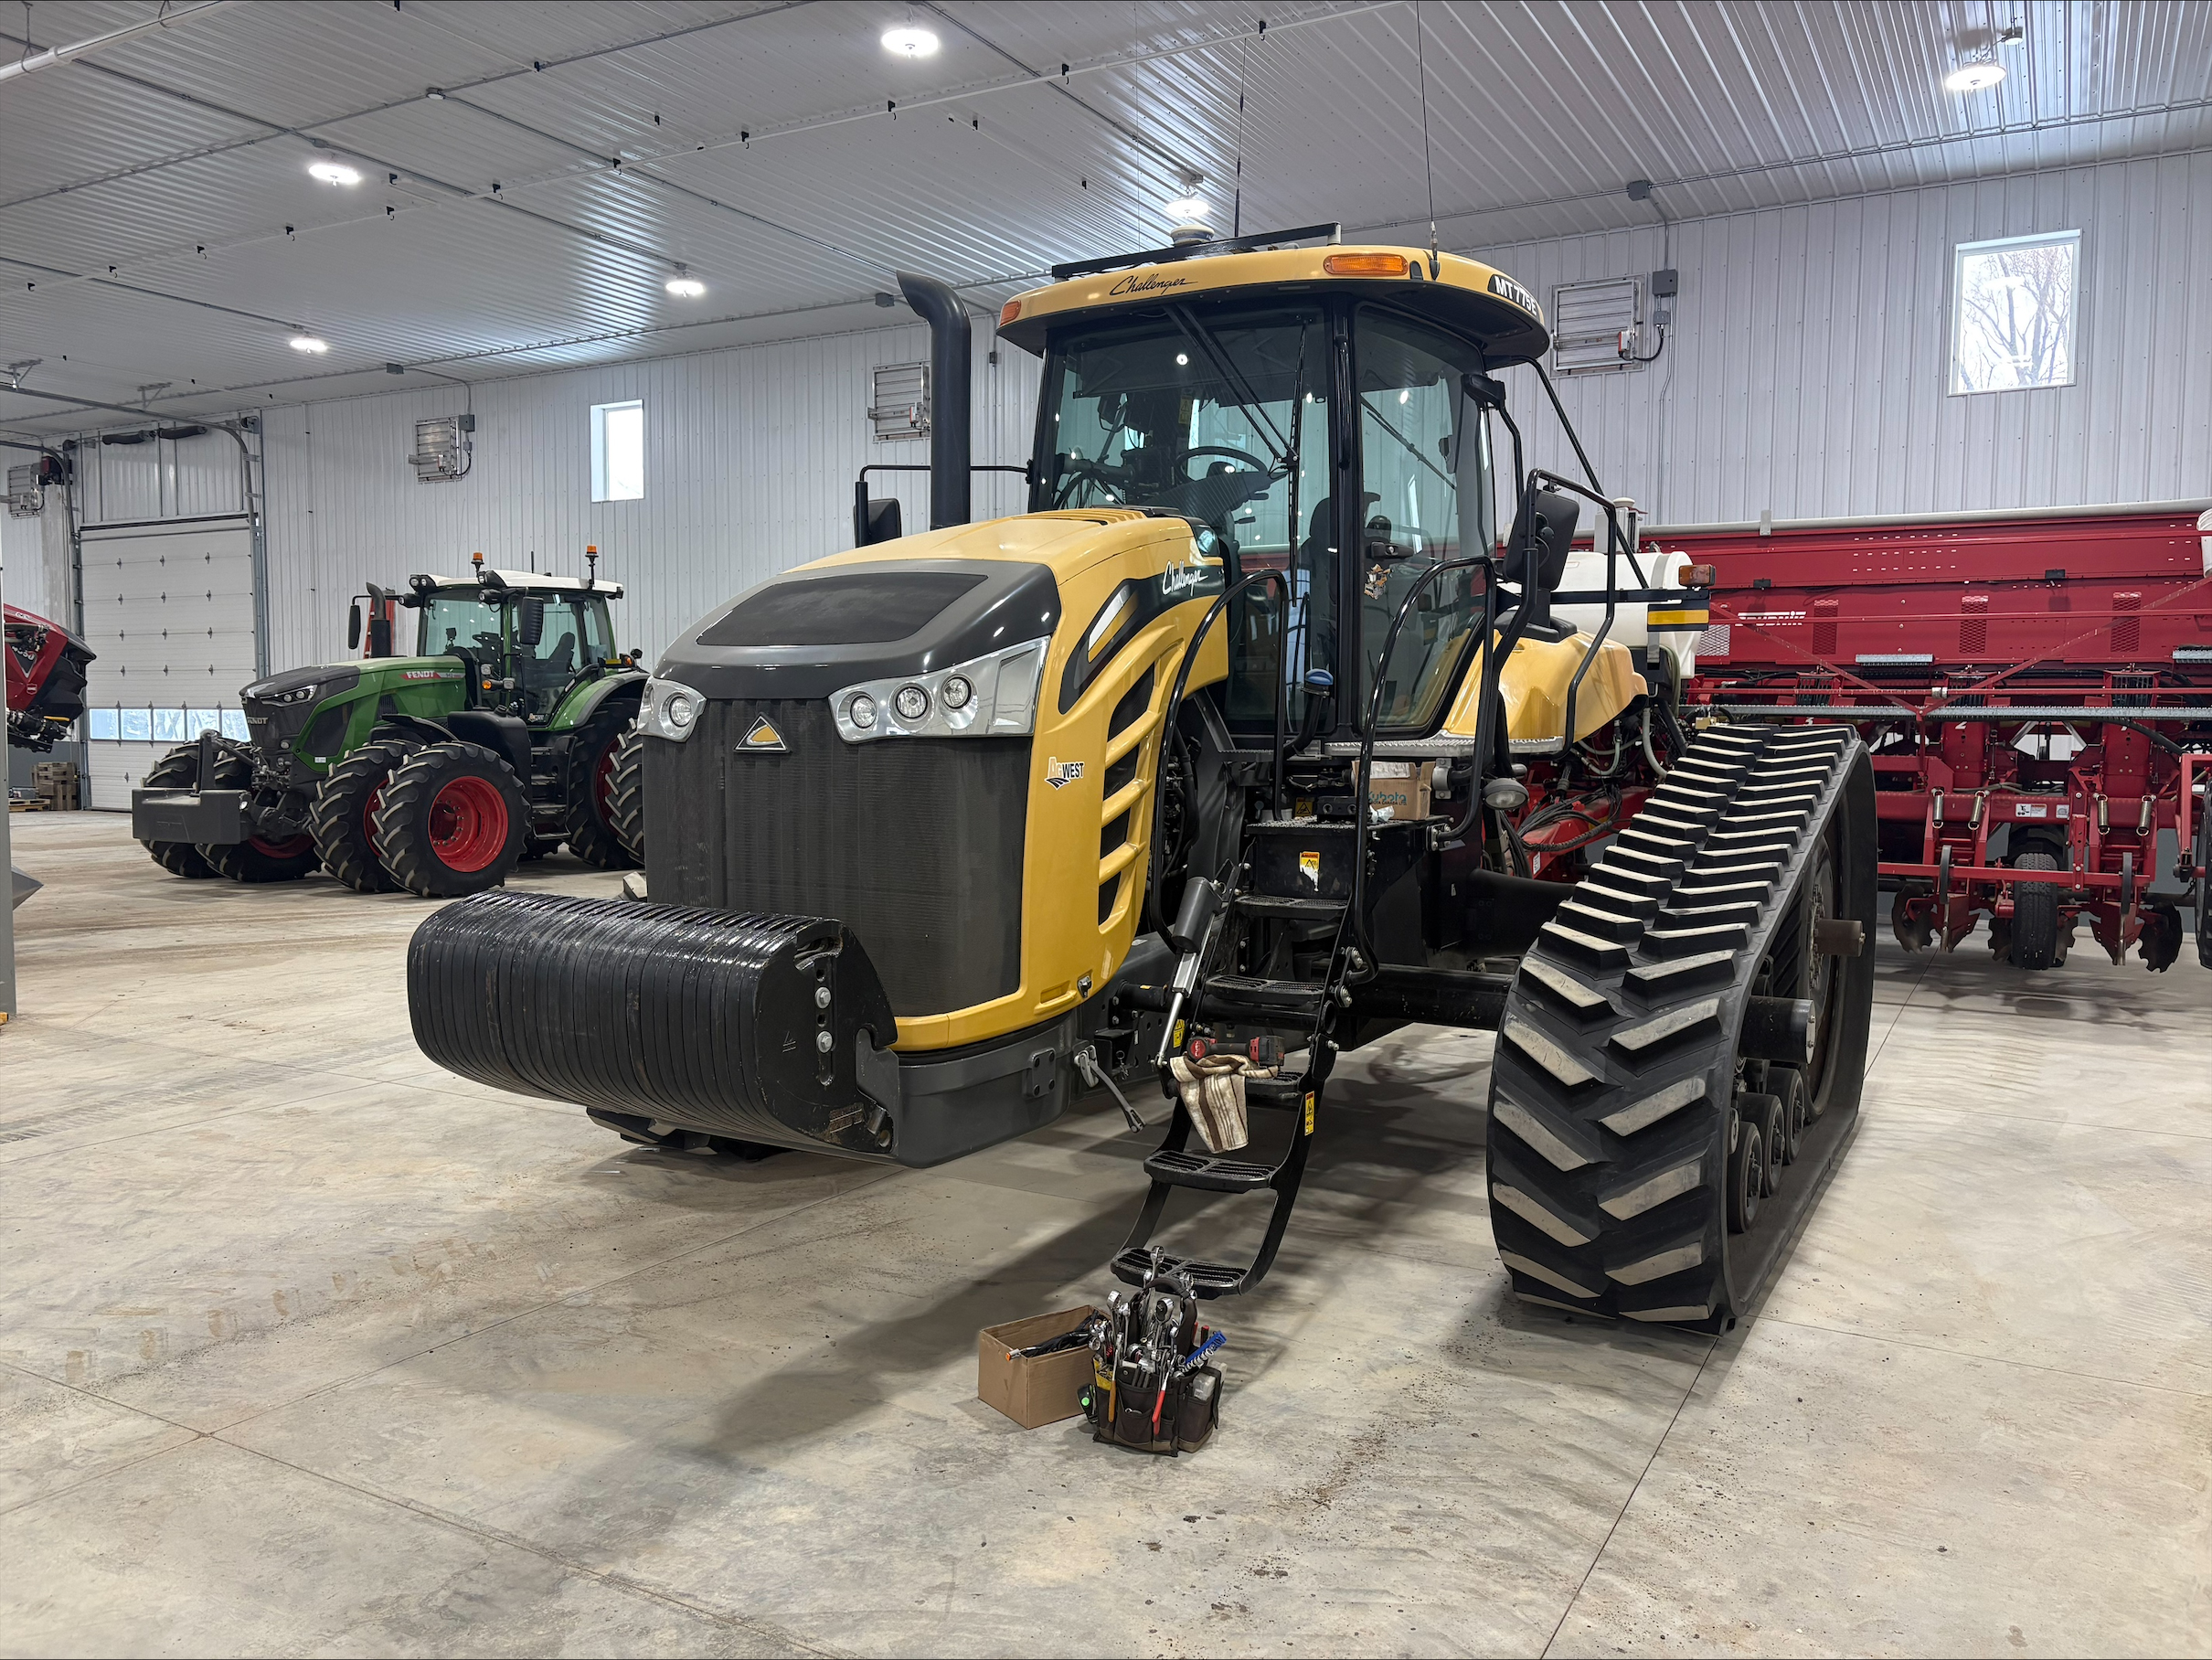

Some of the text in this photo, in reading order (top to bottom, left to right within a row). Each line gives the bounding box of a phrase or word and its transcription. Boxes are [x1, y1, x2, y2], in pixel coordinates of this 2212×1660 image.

[1109, 273, 1198, 295] Challenger
[1162, 559, 1208, 597] Challenger
[406, 670, 435, 679] FENDT
